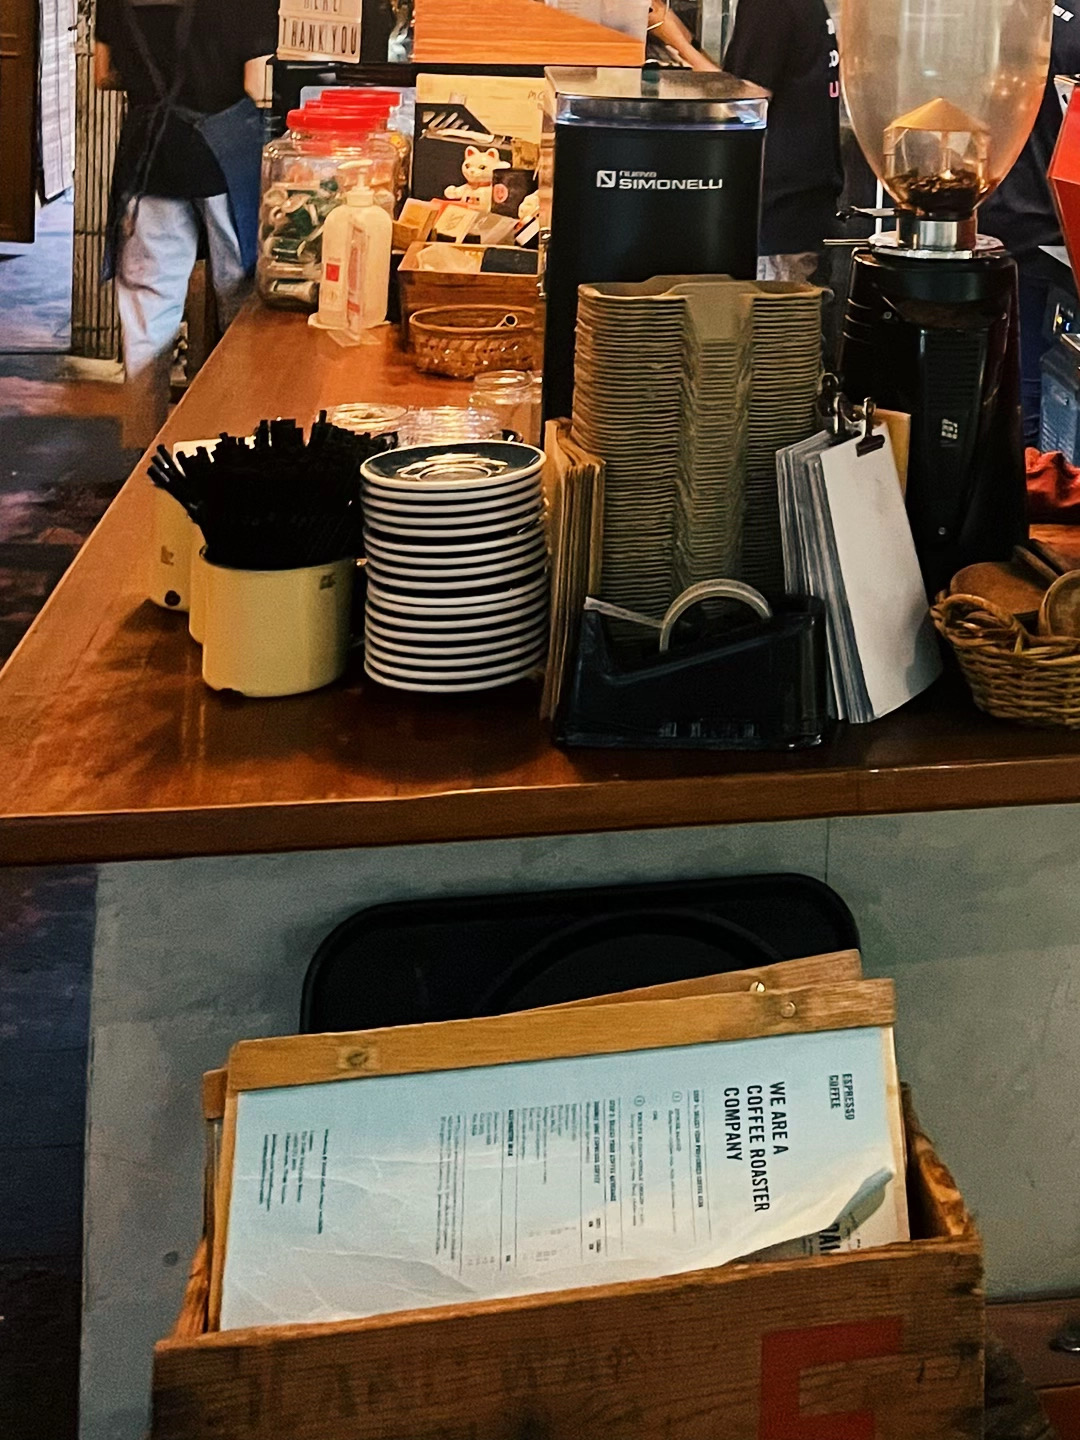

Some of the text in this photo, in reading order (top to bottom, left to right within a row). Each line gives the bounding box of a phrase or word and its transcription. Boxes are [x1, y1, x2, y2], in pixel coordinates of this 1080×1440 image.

[282, 18, 358, 55] THANK YOU
[619, 179, 723, 190] SIMONELLI
[829, 1075, 841, 1109] COFFEE
[842, 1073, 855, 1120] ESPRESSO
[724, 1087, 743, 1161] COMPANY
[769, 1081, 789, 1155] WE ARE A
[747, 1085, 770, 1212] COFFEE ROASTER
